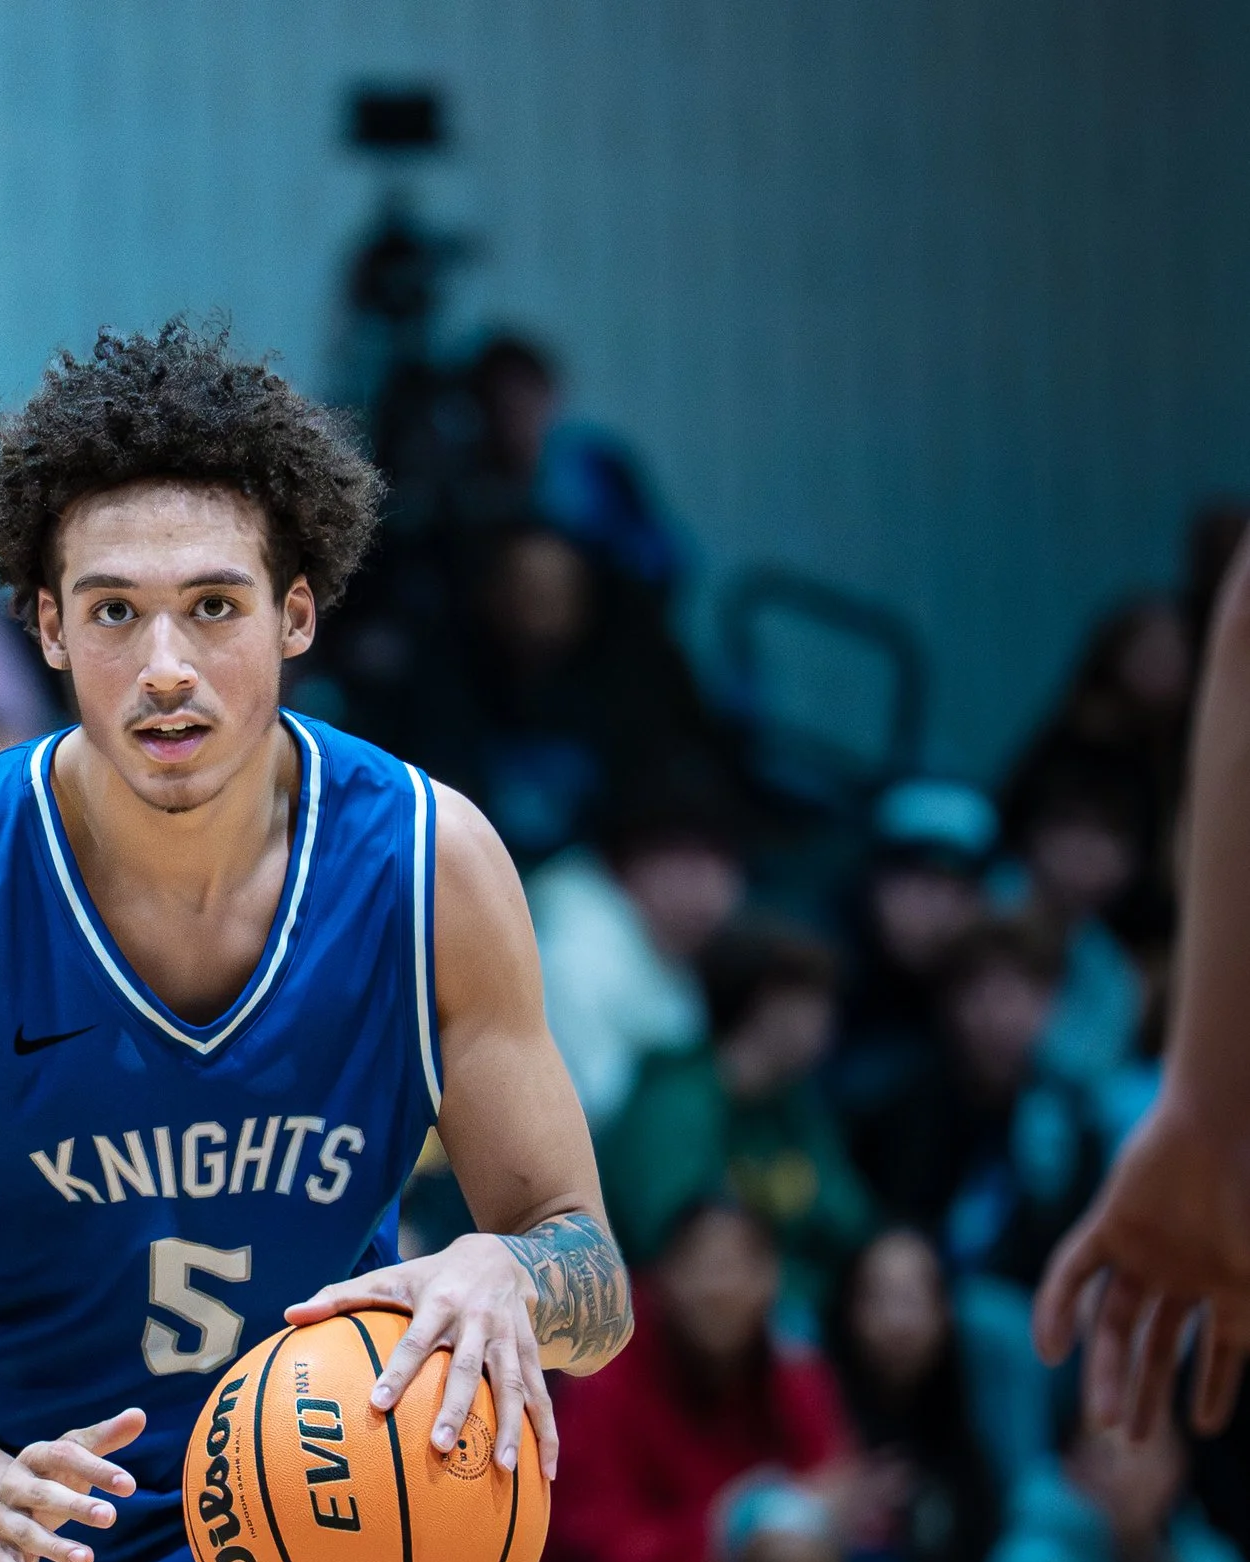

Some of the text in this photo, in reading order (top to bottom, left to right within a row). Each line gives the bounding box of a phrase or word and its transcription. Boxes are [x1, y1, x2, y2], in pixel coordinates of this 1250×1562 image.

[29, 1115, 366, 1205] KNIGHTS
[141, 1236, 252, 1377] 5
[234, 1457, 244, 1492] GAME
[293, 1360, 362, 1534] EVO NXT
[239, 1494, 258, 1540] INDOOR
